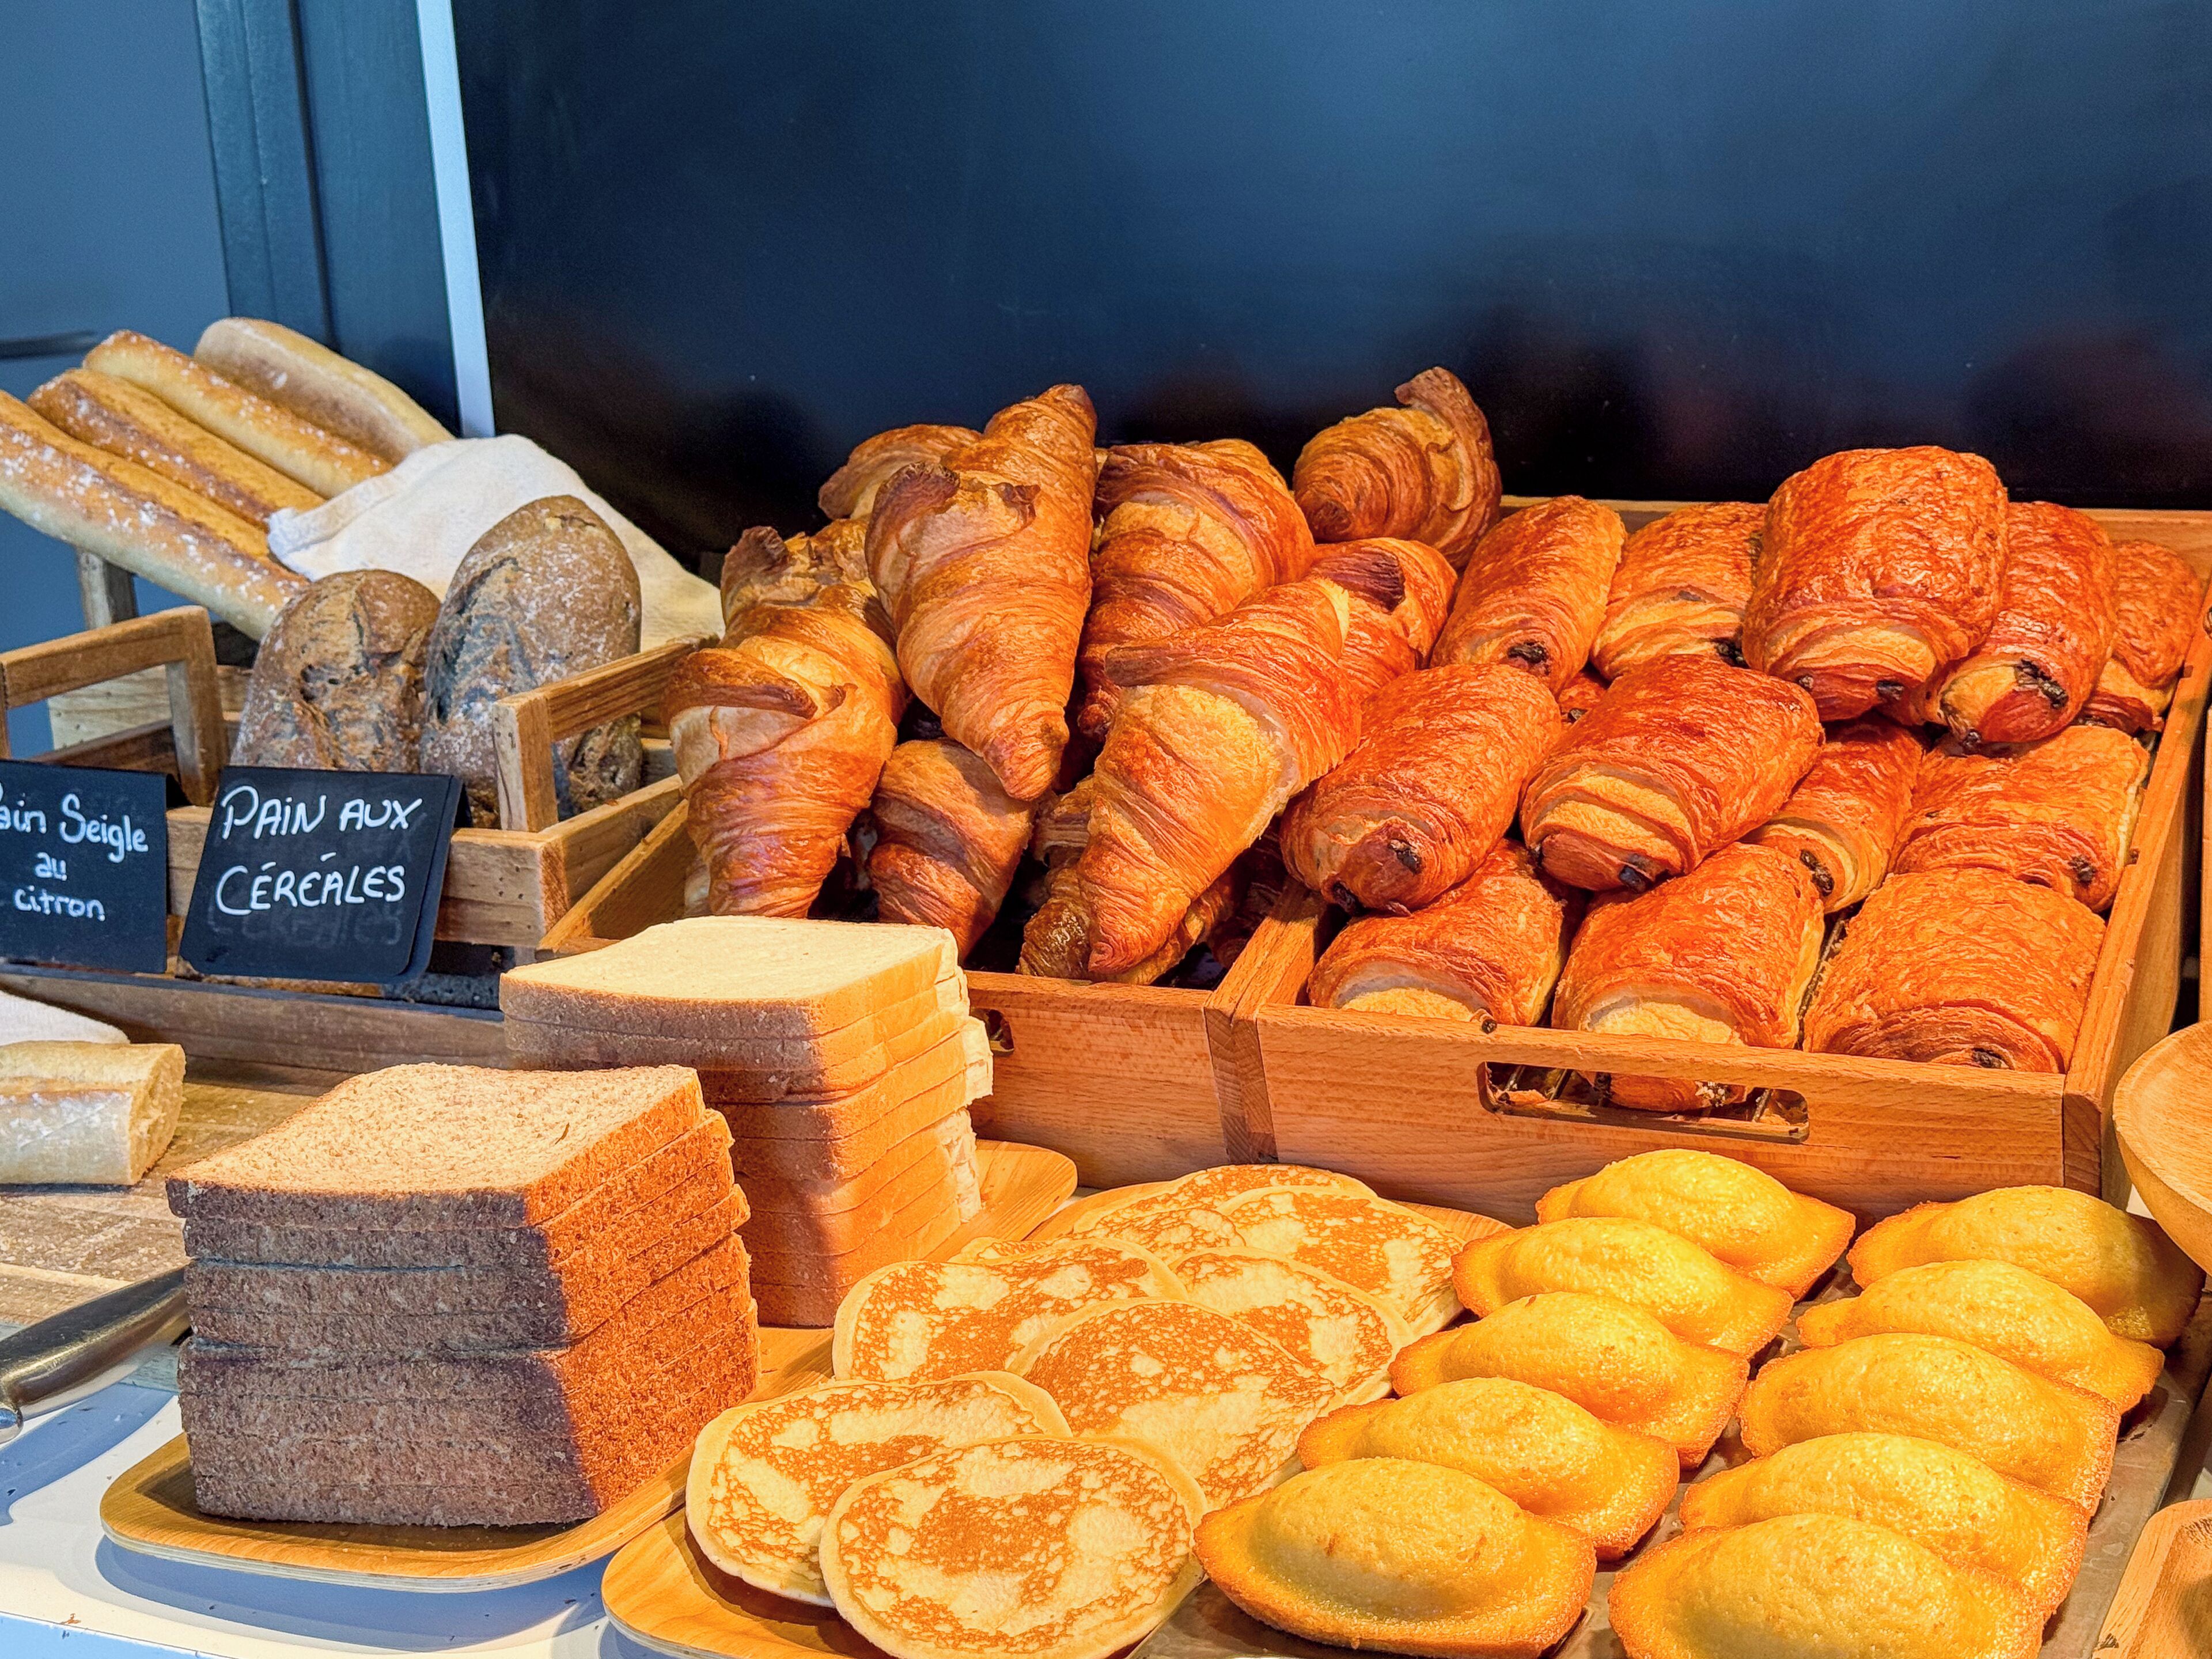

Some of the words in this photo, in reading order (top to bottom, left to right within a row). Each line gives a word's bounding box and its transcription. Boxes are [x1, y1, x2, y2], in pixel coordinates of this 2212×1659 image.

[0, 782, 47, 834] ain
[59, 793, 149, 863] Seigle
[339, 798, 423, 832] AUX
[35, 852, 67, 881] au
[215, 852, 405, 915] CÉRÉALES
[14, 885, 105, 922] citron
